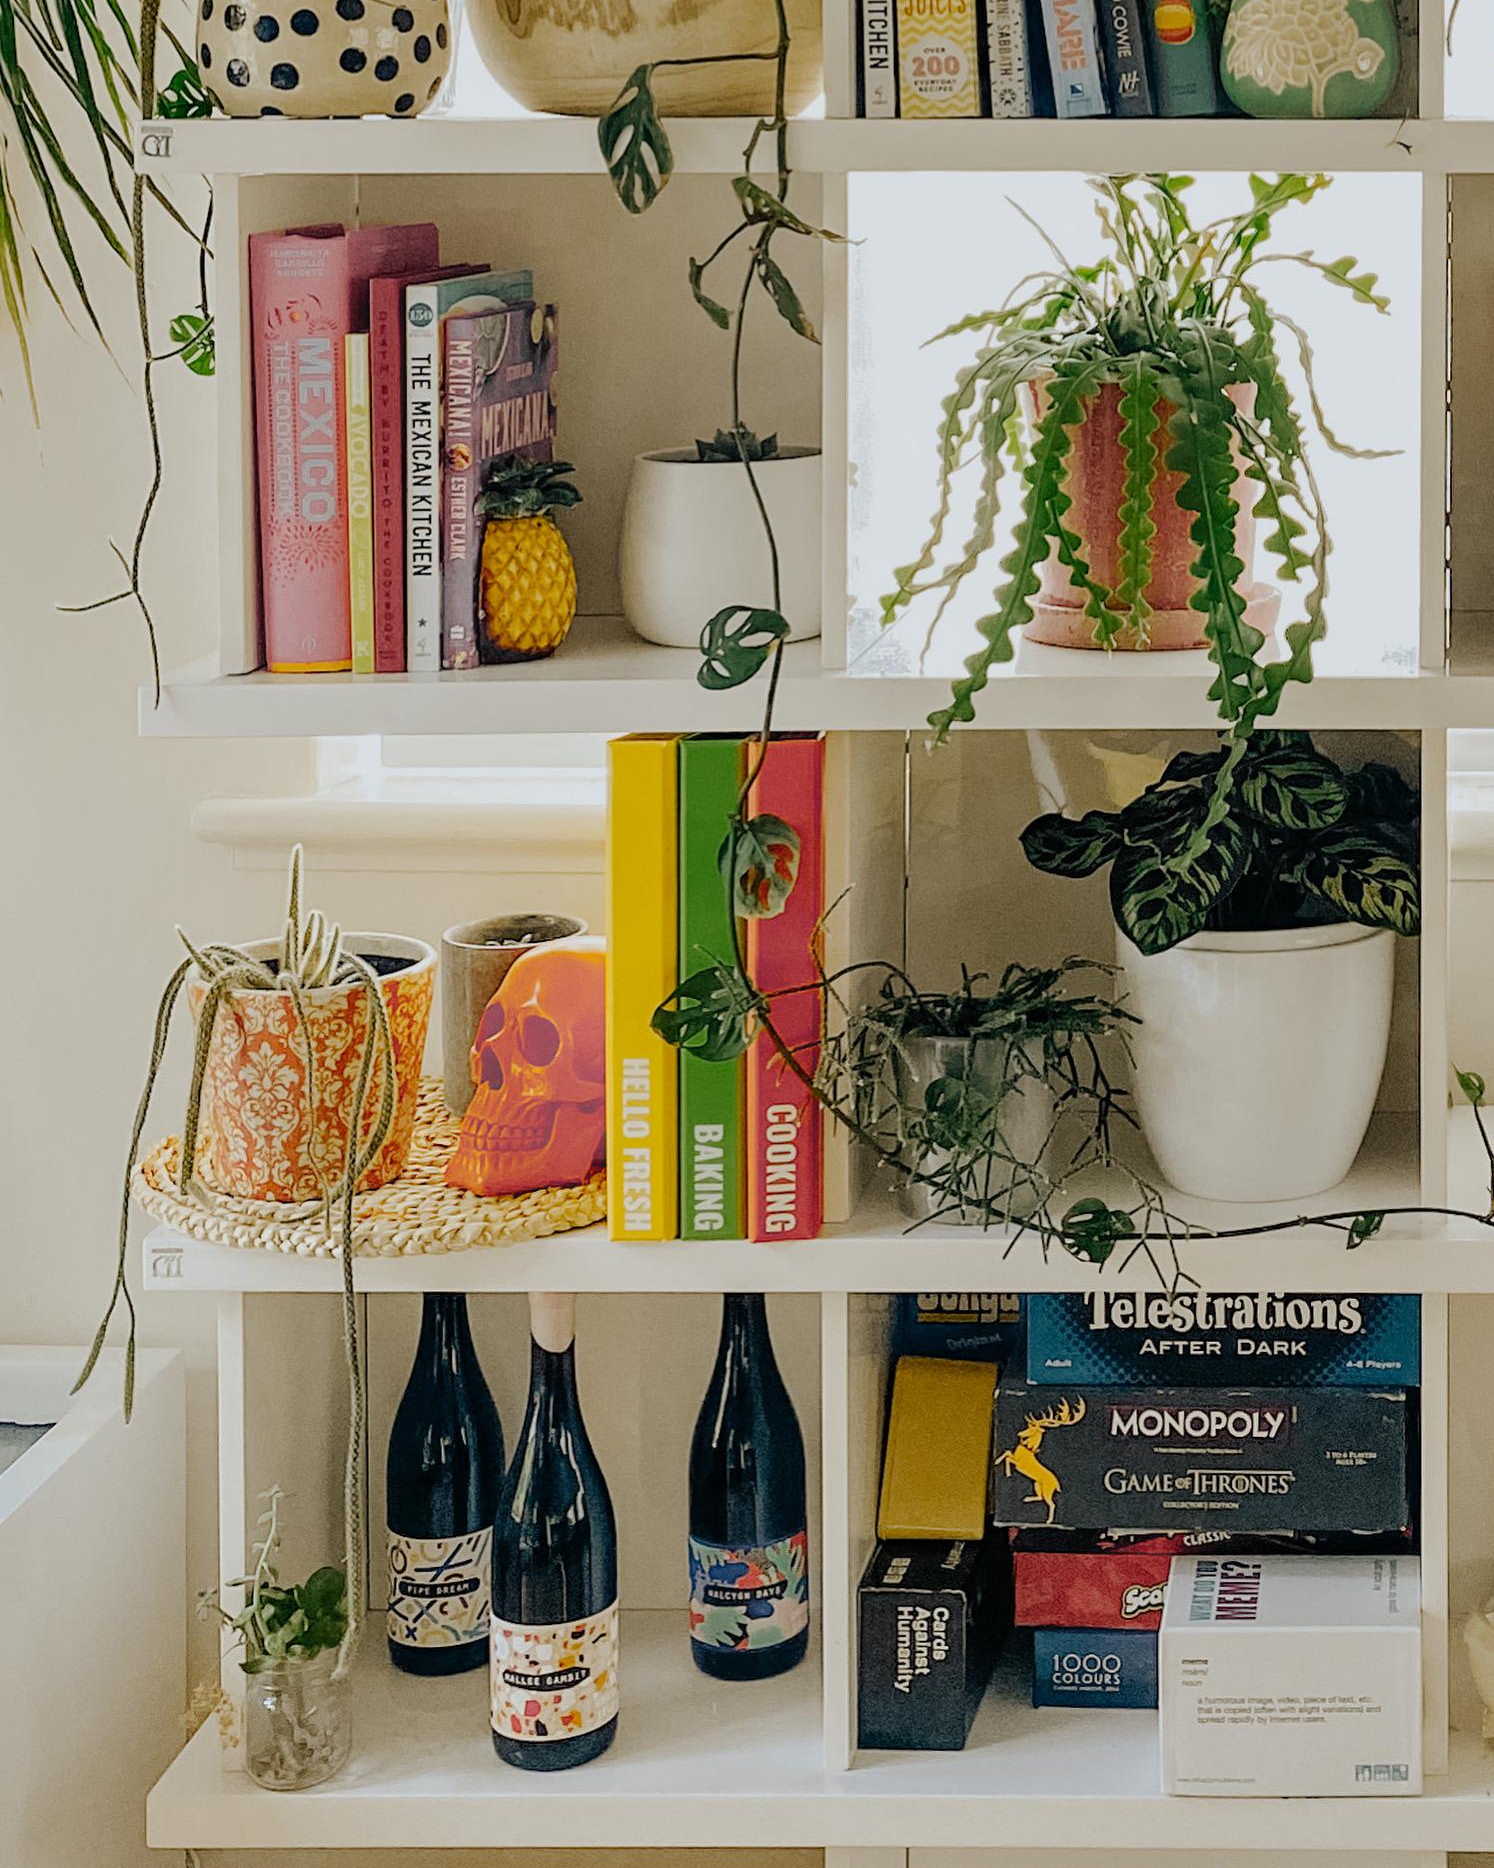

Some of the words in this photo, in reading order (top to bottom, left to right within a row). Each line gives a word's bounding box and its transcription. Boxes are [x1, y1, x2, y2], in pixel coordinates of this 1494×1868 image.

[997, 21, 1012, 76] SABBATH
[1111, 4, 1133, 59] COWIE
[911, 55, 961, 77] 200
[409, 308, 433, 322] 150
[271, 341, 289, 384] THE
[411, 354, 431, 390] THE
[447, 340, 470, 437] MEXICANA!
[296, 337, 336, 523] MEXICO
[410, 400, 432, 486] MEXICAN
[273, 388, 293, 518] COOKBOOK
[348, 413, 370, 518] AVOCADO
[450, 476, 466, 520] ESTHER
[412, 494, 432, 576] KITCHEN
[450, 523, 466, 561] CLARK
[621, 1057, 651, 1139] HELLO
[622, 1147, 653, 1233] FRESH
[693, 1123, 724, 1233] BAKING
[765, 1103, 798, 1235] COOKING
[1084, 1291, 1363, 1334] Telestrations
[1139, 1339, 1222, 1356] AFTER
[1237, 1339, 1307, 1356] DARK
[1366, 1360, 1401, 1370] Players
[1110, 1409, 1285, 1438] MONOPOLY
[1104, 1468, 1174, 1494] GAME
[1188, 1469, 1296, 1496] THRONES
[407, 1584, 431, 1595] PIPE
[436, 1583, 470, 1595] DREAM
[708, 1589, 751, 1600] HALCYON
[1215, 1560, 1262, 1621] MEME?
[894, 1606, 914, 1693] Humanity
[912, 1606, 931, 1675] Against
[932, 1606, 950, 1661] Cards
[1052, 1653, 1121, 1674] 1000
[1052, 1673, 1121, 1685] COLOURS
[1197, 1716, 1226, 1725] spread
[1257, 1716, 1267, 1725] by
[1204, 1696, 1245, 1704] humorous
[1223, 1706, 1252, 1715] copied
